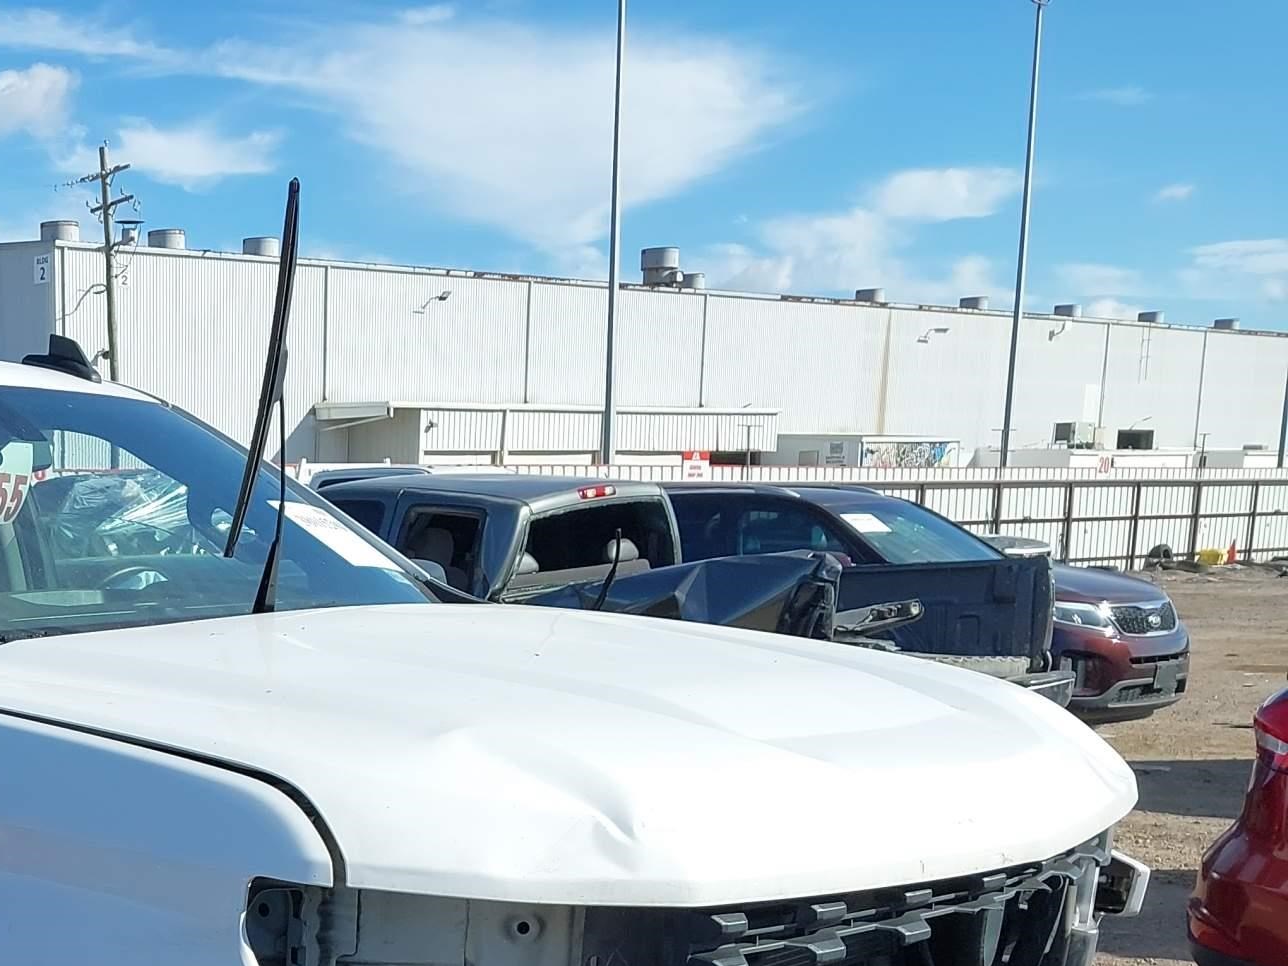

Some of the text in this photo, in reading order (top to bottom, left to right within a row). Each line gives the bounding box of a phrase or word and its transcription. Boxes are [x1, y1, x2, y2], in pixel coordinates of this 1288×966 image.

[39, 266, 45, 280] 2
[121, 275, 129, 286] 2
[1099, 456, 1109, 473] 20
